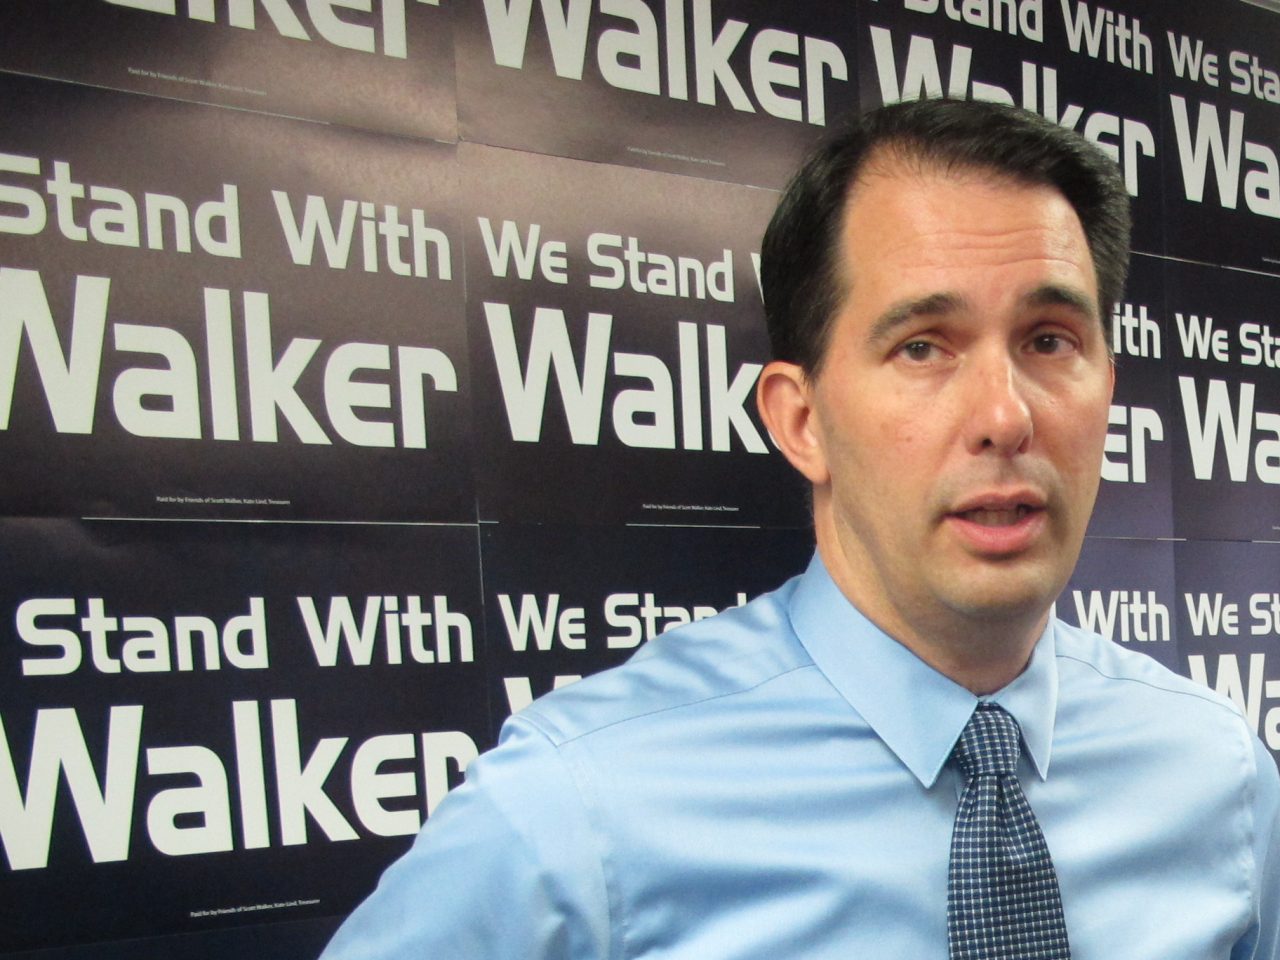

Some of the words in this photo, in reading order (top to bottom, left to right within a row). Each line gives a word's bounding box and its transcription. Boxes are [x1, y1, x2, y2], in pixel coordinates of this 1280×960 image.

[1061, 0, 1153, 74] With
[0, 154, 241, 258] Stand
[272, 186, 453, 280] With
[587, 233, 734, 302] Stand
[0, 267, 457, 448] Walker
[1113, 303, 1161, 358] ith
[483, 302, 769, 453] Walk
[16, 597, 268, 675] Stand
[297, 596, 473, 666] With
[1073, 591, 1170, 641] With
